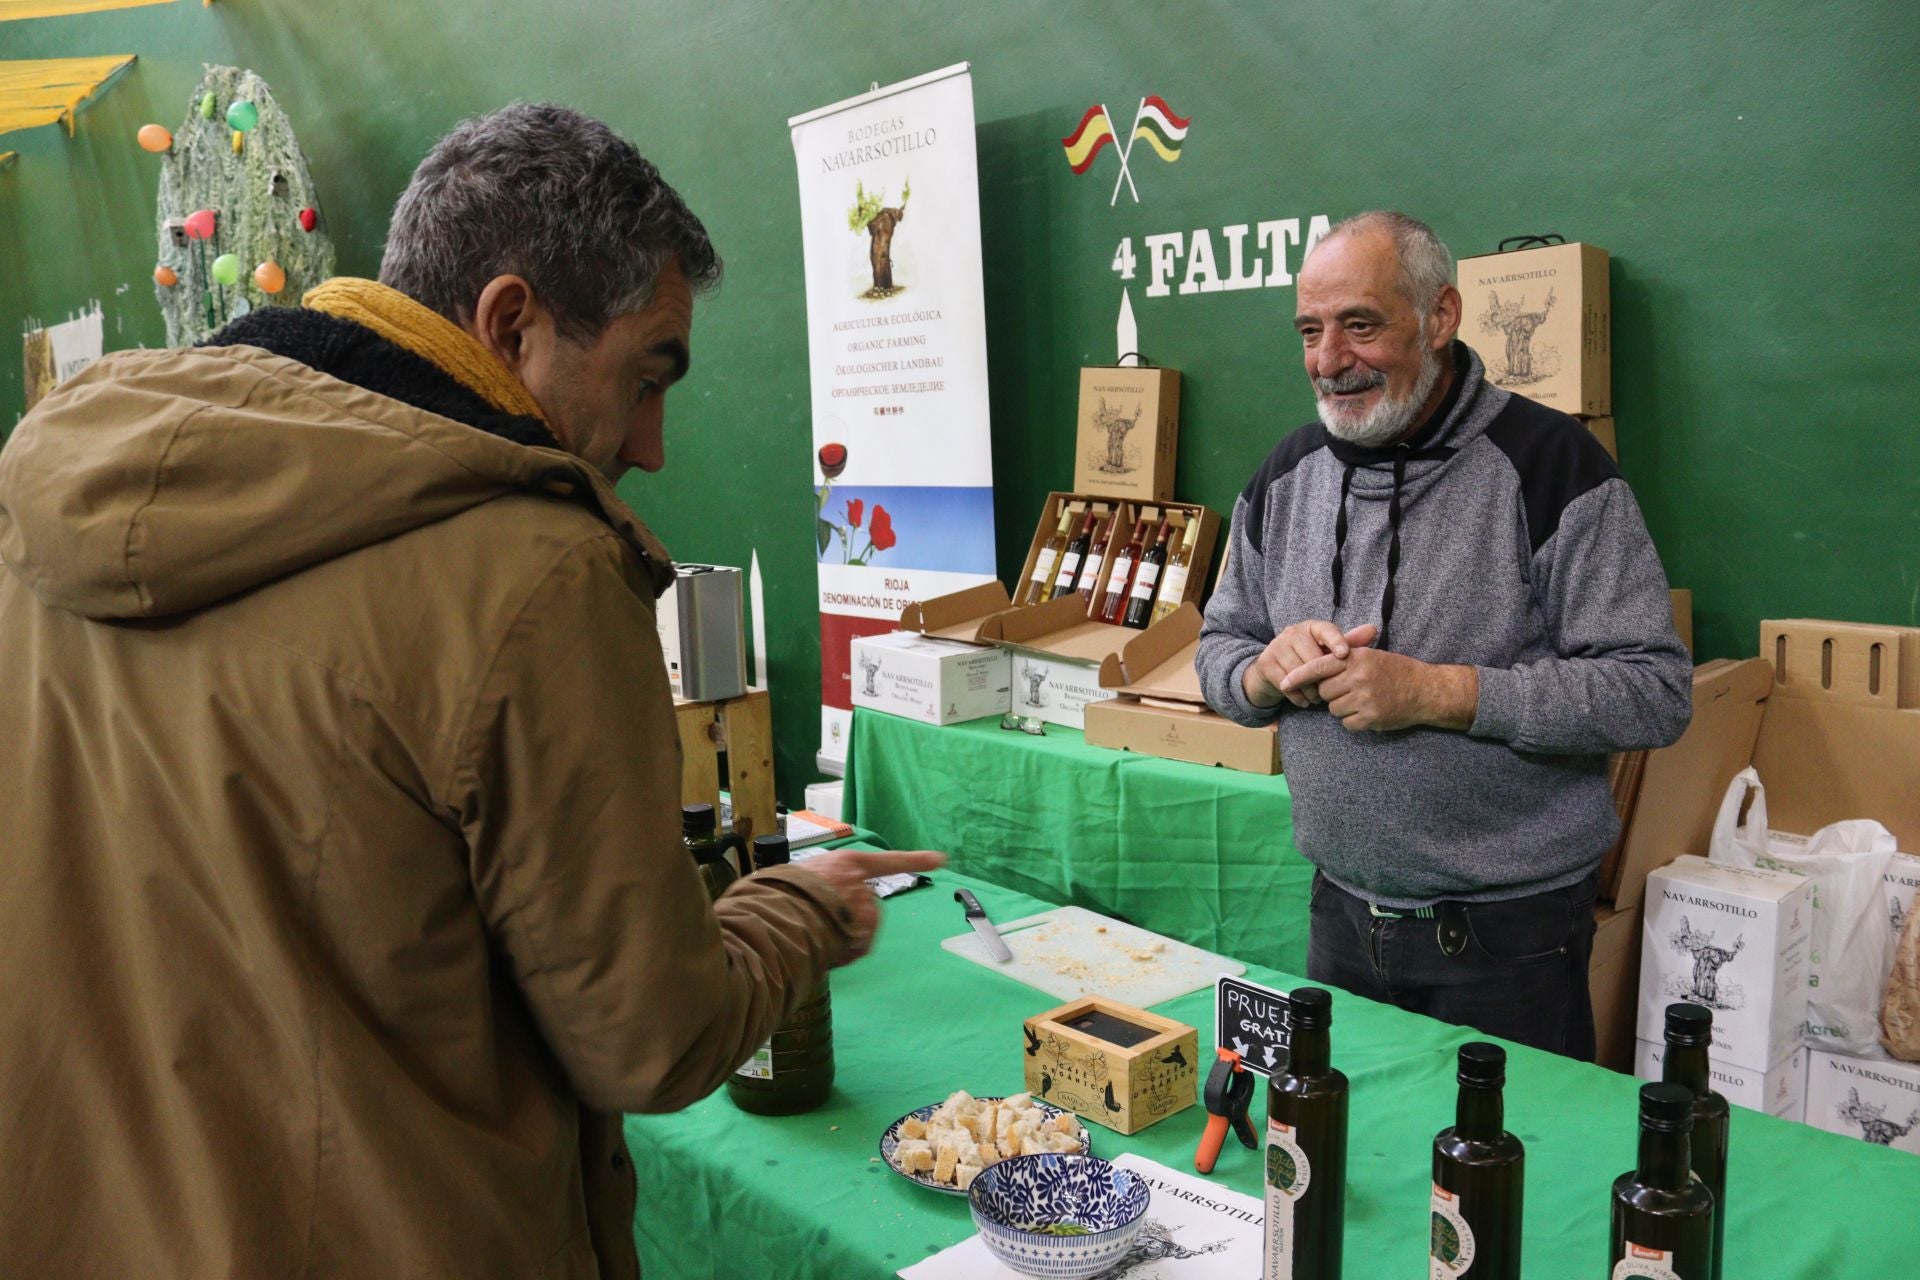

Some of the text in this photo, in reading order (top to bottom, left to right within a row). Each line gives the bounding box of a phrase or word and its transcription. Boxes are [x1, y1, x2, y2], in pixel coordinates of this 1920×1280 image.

[848, 116, 904, 143] BODEGAS
[822, 128, 937, 173] NAVARRSOTILLO
[1111, 237, 1136, 279] 4
[1478, 268, 1557, 286] NAVARRSOTILLO
[832, 309, 942, 332] AGRICULTURA ECOLÓGICA
[847, 335, 926, 352] ORGANIC FARMING
[836, 357, 944, 376] ÖKOLOGISCHER LANDBAU
[1093, 385, 1144, 394] NAVARRSOTILLO
[884, 578, 910, 591] RIOJA
[823, 592, 881, 609] DENOMINACIÓN
[883, 598, 894, 610] DE
[882, 671, 933, 689] NAVARRSOTILLO
[1048, 680, 1109, 698] NAVARRSOTILLO
[1662, 890, 1758, 919] NAVARRSOTILLO
[1141, 1174, 1265, 1226] AVARRSOTILL
[1271, 1195, 1280, 1280] NAVARRSOTILLO
